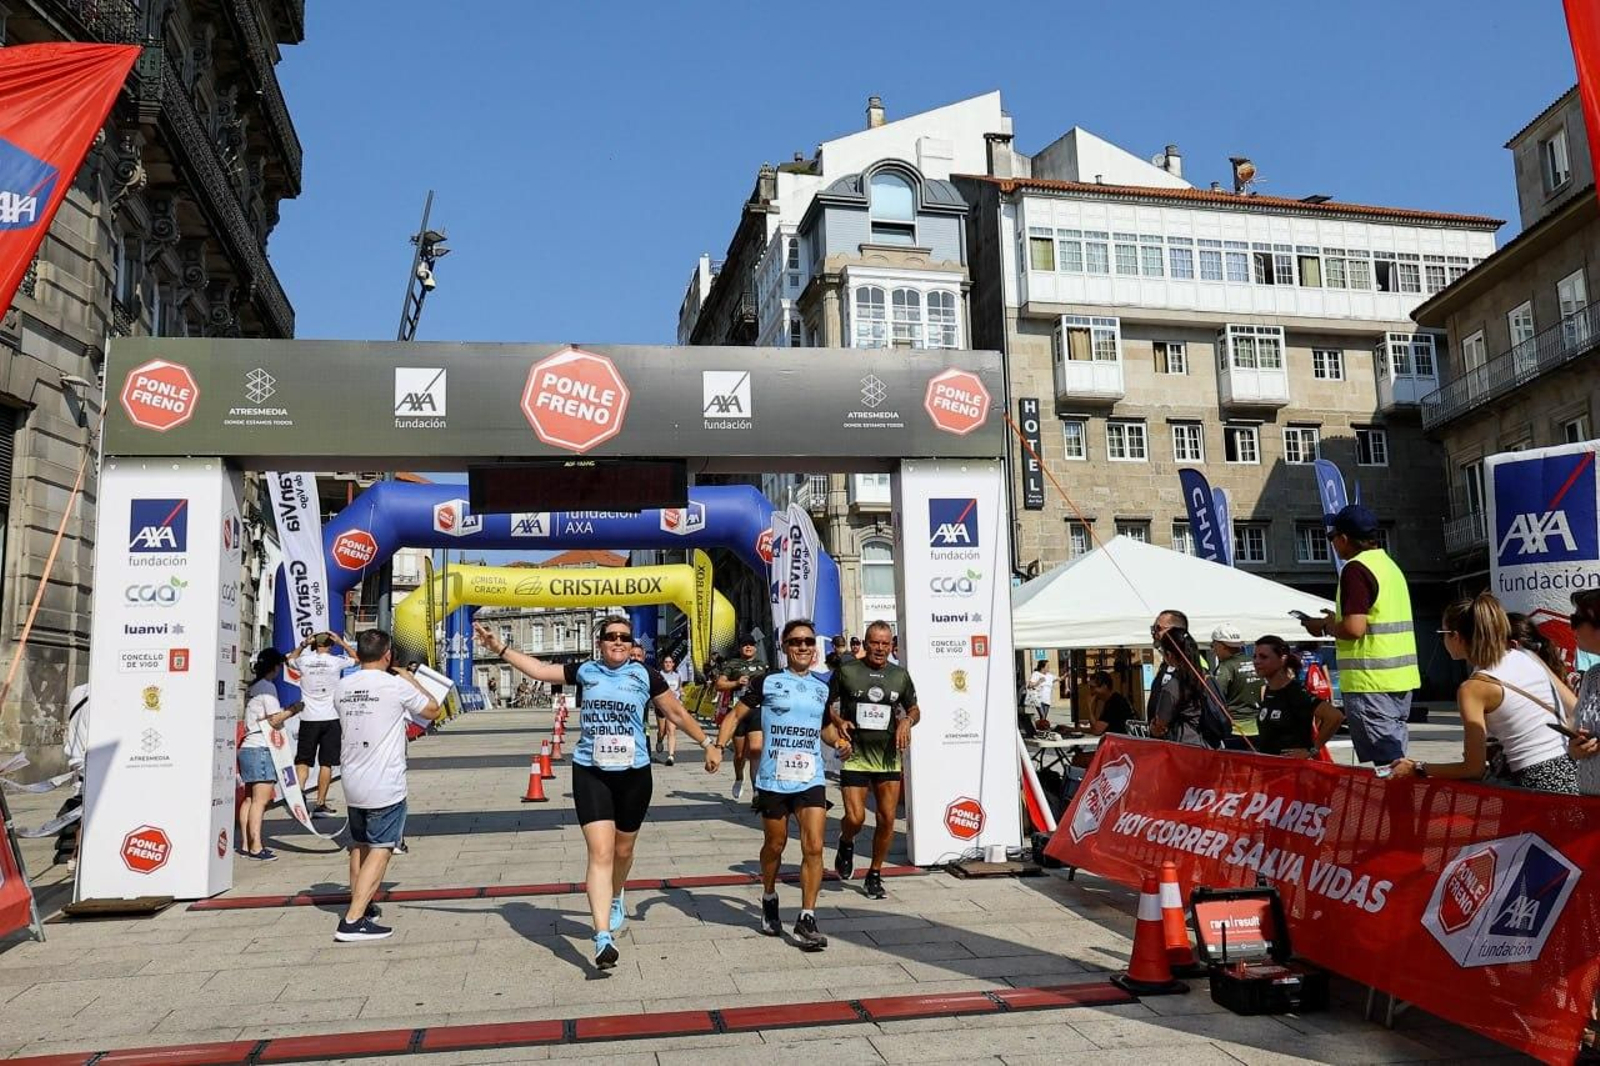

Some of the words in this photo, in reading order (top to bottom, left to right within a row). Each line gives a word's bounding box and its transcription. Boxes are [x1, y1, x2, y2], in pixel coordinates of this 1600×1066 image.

[136, 376, 190, 400] PONLE
[542, 372, 616, 407] PONLE
[936, 384, 982, 407] PONLE
[132, 390, 185, 414] FRENO
[395, 393, 436, 411] AXA
[536, 392, 610, 425] FRENO
[704, 395, 743, 413] AXA
[932, 396, 980, 418] FRENO
[229, 408, 288, 416] ATRESMEDIA
[395, 418, 446, 429] fundación
[704, 418, 752, 430] fundación
[1024, 400, 1040, 491] HOTEL
[512, 520, 542, 534] AXA
[565, 522, 594, 534] AXA
[930, 523, 970, 543] AXA
[1498, 510, 1578, 557] AXA
[129, 526, 178, 548] AXA
[340, 538, 374, 554] PONLE
[129, 555, 187, 566] fundación
[338, 546, 370, 560] FRENO
[930, 550, 980, 560] fundación
[550, 577, 662, 596] CRISTALBOX
[1499, 567, 1600, 592] fundación
[932, 613, 968, 622] luanvi
[124, 624, 168, 634] luanvi
[950, 816, 979, 830] FRENO
[951, 808, 981, 822] PONLE
[1178, 786, 1216, 812] NO
[1241, 792, 1332, 846] PARES,
[126, 846, 162, 862] FRENO
[130, 838, 165, 852] PONLE
[1112, 812, 1154, 838] HOY
[1146, 820, 1229, 860] CORRER
[1225, 838, 1305, 886] SALVA
[1307, 859, 1393, 913] VIDAS
[1456, 862, 1486, 900] PONLE
[1448, 878, 1472, 916] FRENO
[1491, 896, 1540, 930] AXA
[1478, 940, 1532, 957] fundación
